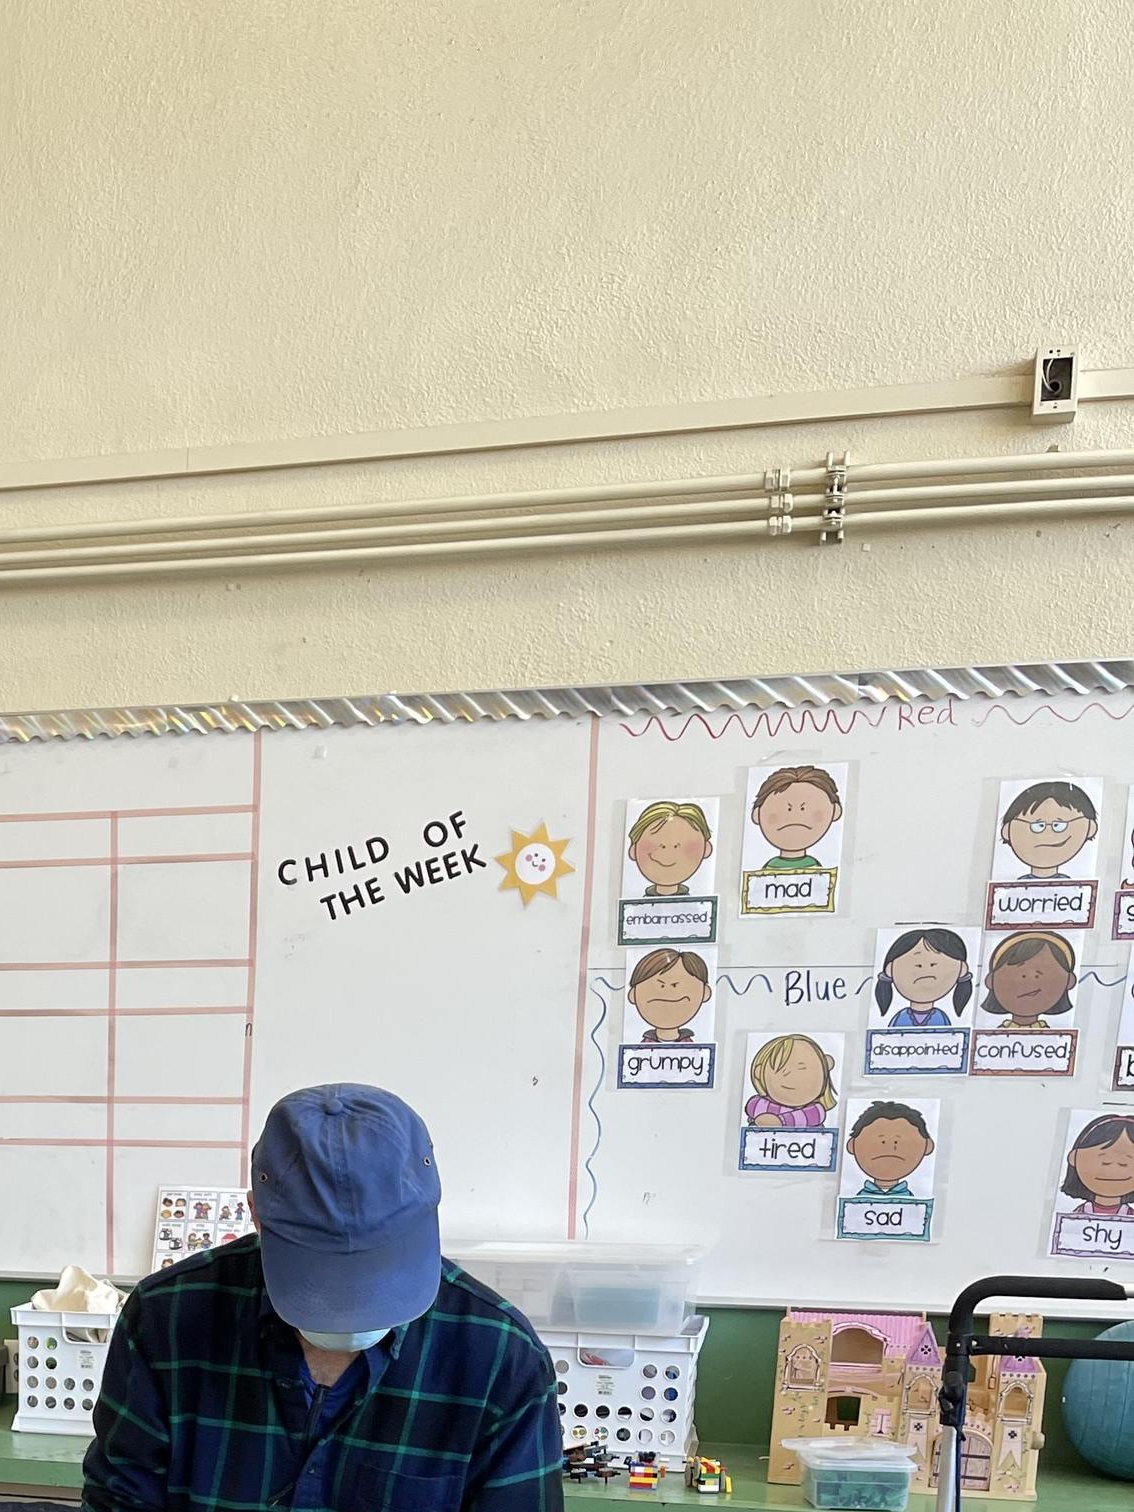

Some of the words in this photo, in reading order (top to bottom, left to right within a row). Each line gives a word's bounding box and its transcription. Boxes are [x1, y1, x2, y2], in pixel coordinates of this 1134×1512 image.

[897, 700, 957, 730] Red
[278, 836, 391, 886] CHILD
[422, 810, 468, 848] OF
[319, 876, 386, 921] THE
[394, 843, 487, 895] WEEK
[764, 877, 813, 900] mad
[997, 892, 1084, 914] worried
[625, 909, 708, 925] embarrassed
[784, 969, 847, 1007] Blue
[872, 1041, 960, 1059] disappointed
[976, 1040, 1068, 1060] confused
[627, 1053, 704, 1077] grumpy
[758, 1136, 816, 1161] tired
[864, 1206, 903, 1227] sad
[1081, 1222, 1123, 1251] shy
